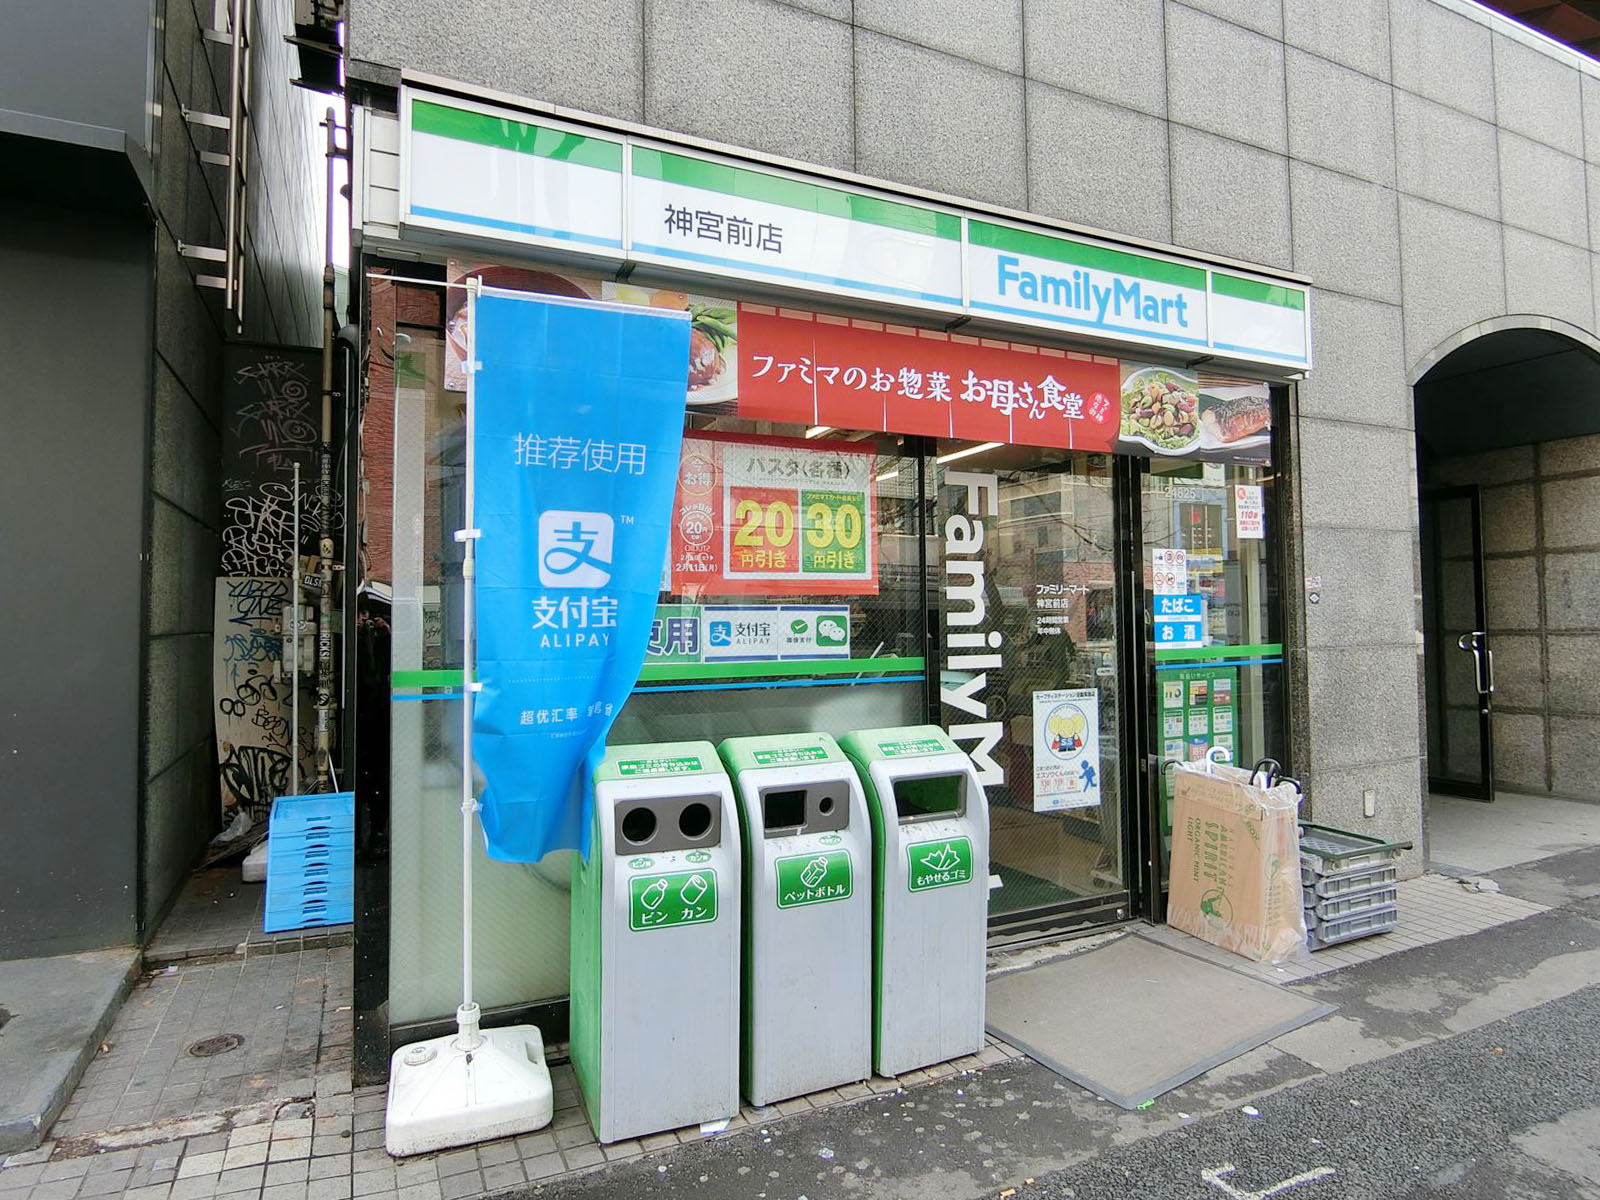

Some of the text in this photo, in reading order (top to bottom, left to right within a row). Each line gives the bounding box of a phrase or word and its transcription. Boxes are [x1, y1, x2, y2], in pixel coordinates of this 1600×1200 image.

[664, 203, 783, 254] 神宮前店
[997, 254, 1189, 328] FamilyMart
[752, 355, 953, 402] ファミマのお惣菜
[959, 368, 1085, 421] お母さん食堂
[514, 432, 646, 475] 推荐使用
[734, 499, 794, 548] 20
[806, 502, 862, 549] 30
[741, 550, 787, 569] 円引き
[813, 551, 856, 569] 円引き
[1035, 584, 1090, 596] ファミリーマート
[531, 595, 618, 630] 支付宝
[1161, 597, 1195, 613] たばこ
[735, 622, 771, 637] 支付宝
[540, 633, 611, 649] ALIPAY
[519, 706, 579, 726] 超优汇率
[1203, 821, 1219, 882] SPIRIT
[1218, 824, 1228, 887] AMERICAN
[917, 869, 966, 886] もやせるゴミ
[784, 884, 846, 901] ペットボトル
[641, 906, 708, 925] ビン カン
